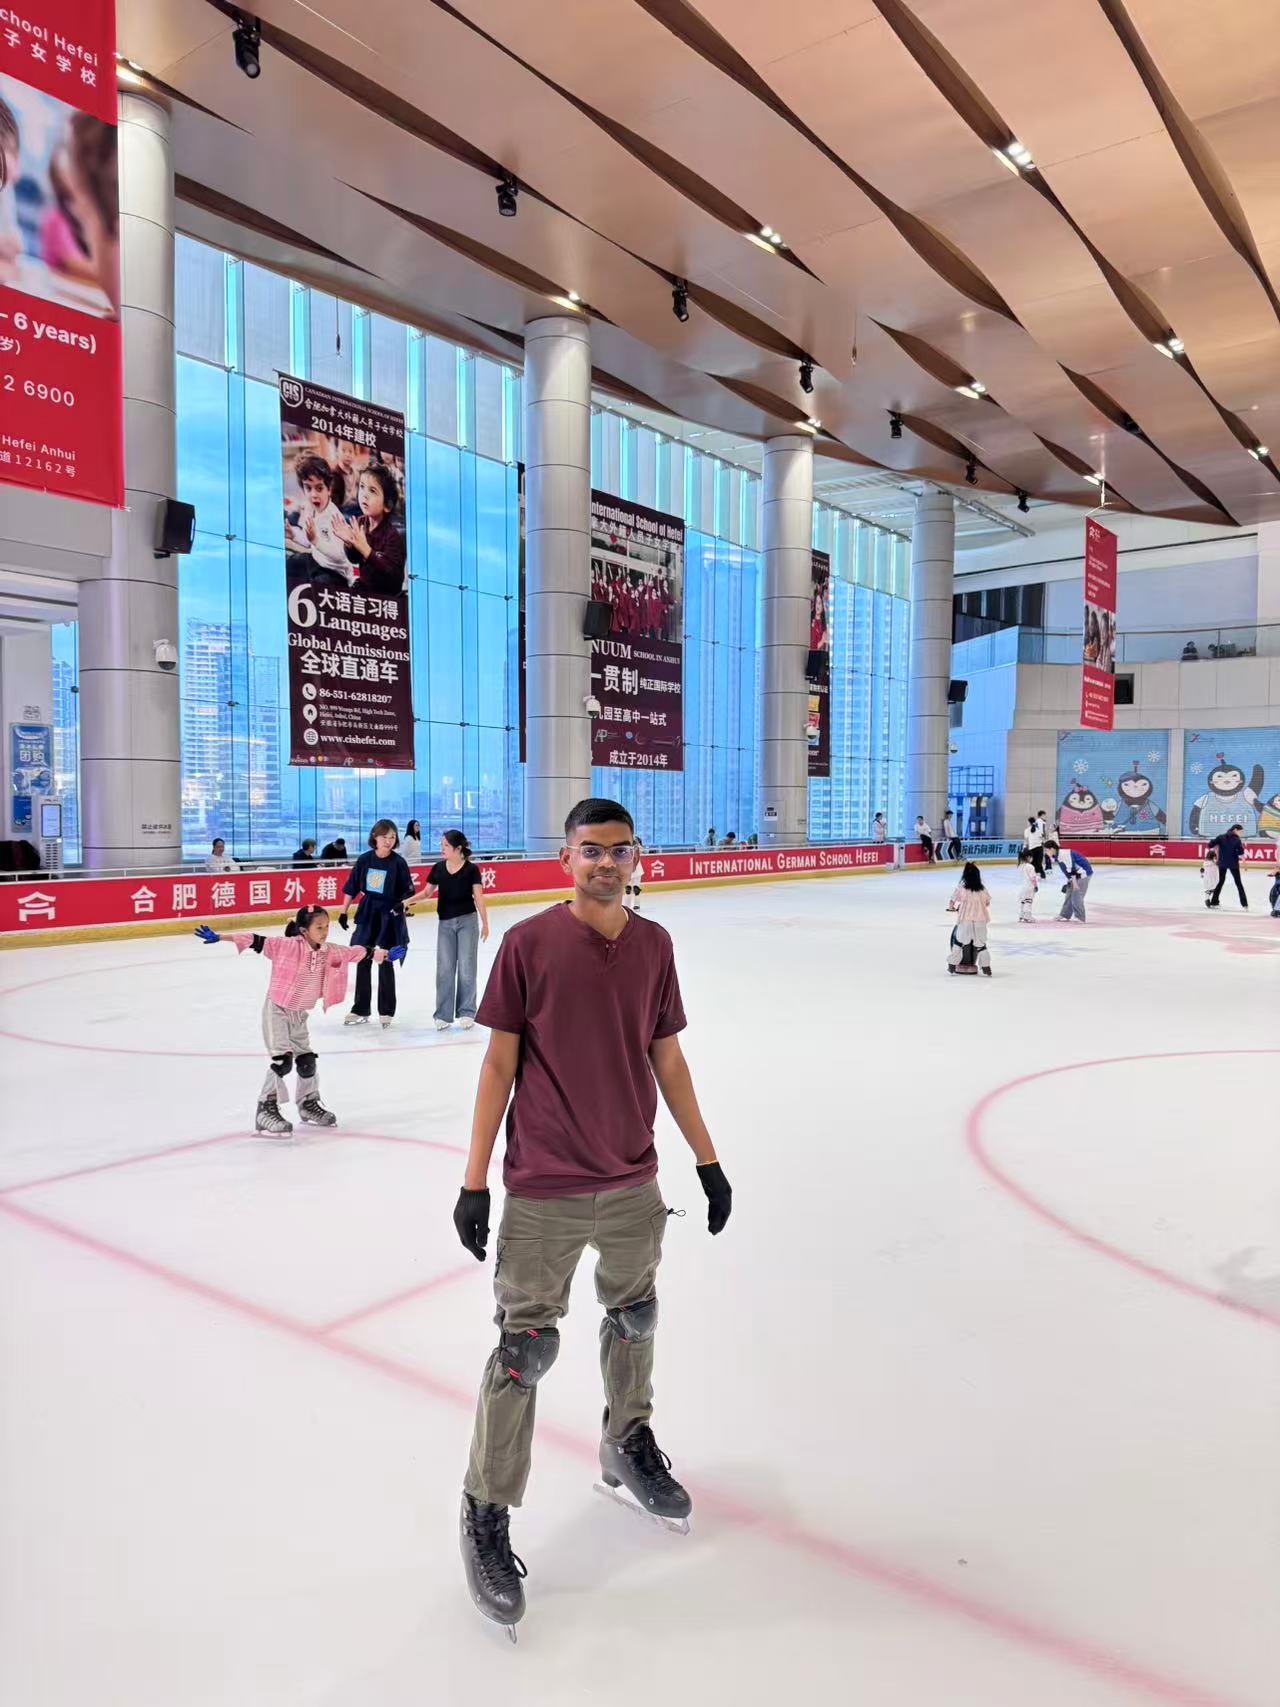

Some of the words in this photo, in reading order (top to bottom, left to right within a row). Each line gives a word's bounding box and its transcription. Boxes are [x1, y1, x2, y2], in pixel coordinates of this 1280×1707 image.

[3, 28, 97, 88] 子女学校
[54, 33, 98, 67] Hefei
[13, 312, 29, 331] 6
[32, 320, 97, 354] years)
[23, 380, 75, 407] 6900
[311, 416, 377, 448] 2014年建校
[2, 434, 36, 451] Hefei
[40, 444, 76, 461] Anhui
[635, 514, 658, 534] School
[658, 523, 666, 537] of
[666, 525, 683, 542] Hefei
[288, 583, 318, 628] 6
[318, 588, 399, 620] 大语言习得
[319, 610, 407, 641] Languages
[288, 632, 332, 652] Global
[334, 640, 410, 662] Admissions
[633, 650, 656, 661] SCHOOL
[656, 654, 663, 662] IN
[663, 656, 681, 665] ANHUI
[300, 649, 399, 684] 全球直通车
[591, 664, 639, 695] 一贯制
[640, 677, 681, 694] 纯正国际学校
[319, 688, 393, 703] 86-551-62818207
[320, 734, 396, 746] www.cishefei.com
[609, 749, 668, 767] 成立于2014年
[690, 857, 773, 876] INTERNATIONAL
[777, 852, 817, 870] GERMAN
[819, 850, 853, 867] SCHOOL
[855, 849, 879, 864] HEFEI
